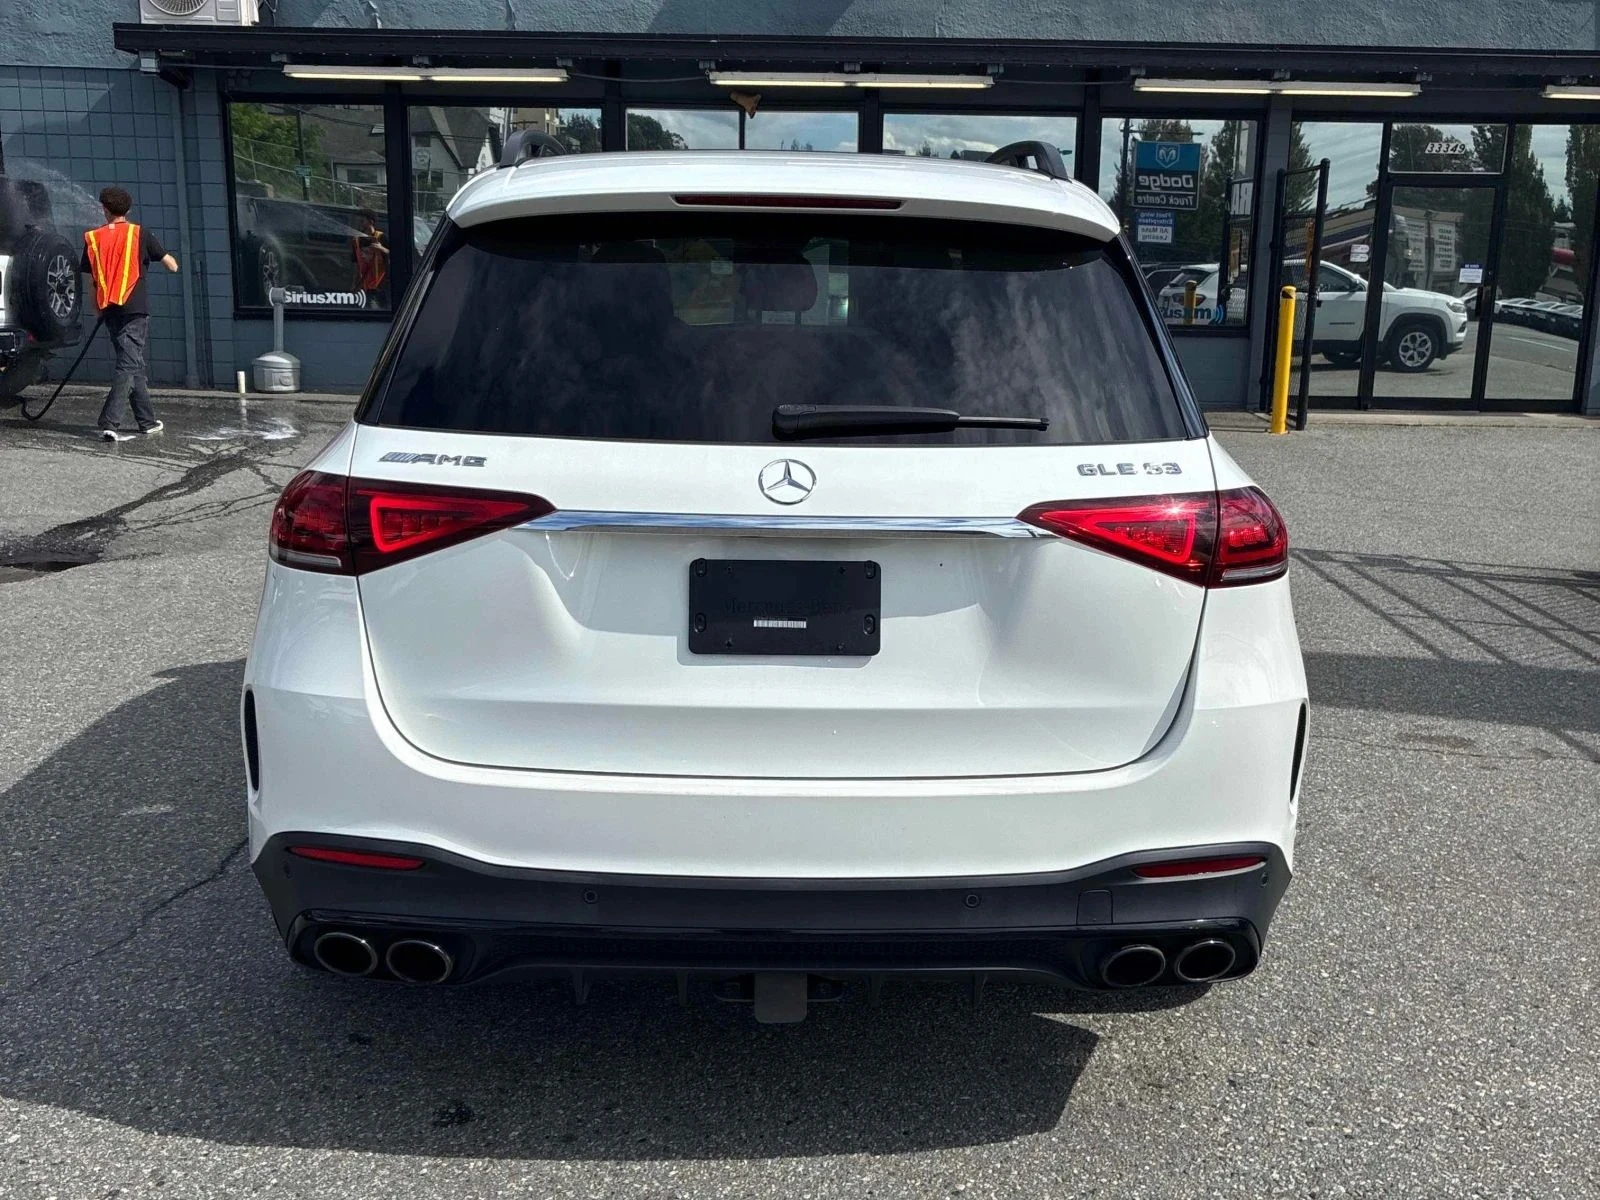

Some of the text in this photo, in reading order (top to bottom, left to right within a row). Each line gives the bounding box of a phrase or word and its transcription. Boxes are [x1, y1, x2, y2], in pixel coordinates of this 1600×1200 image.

[1427, 143, 1466, 153] 33349
[1077, 462, 1183, 476] GLE 53
